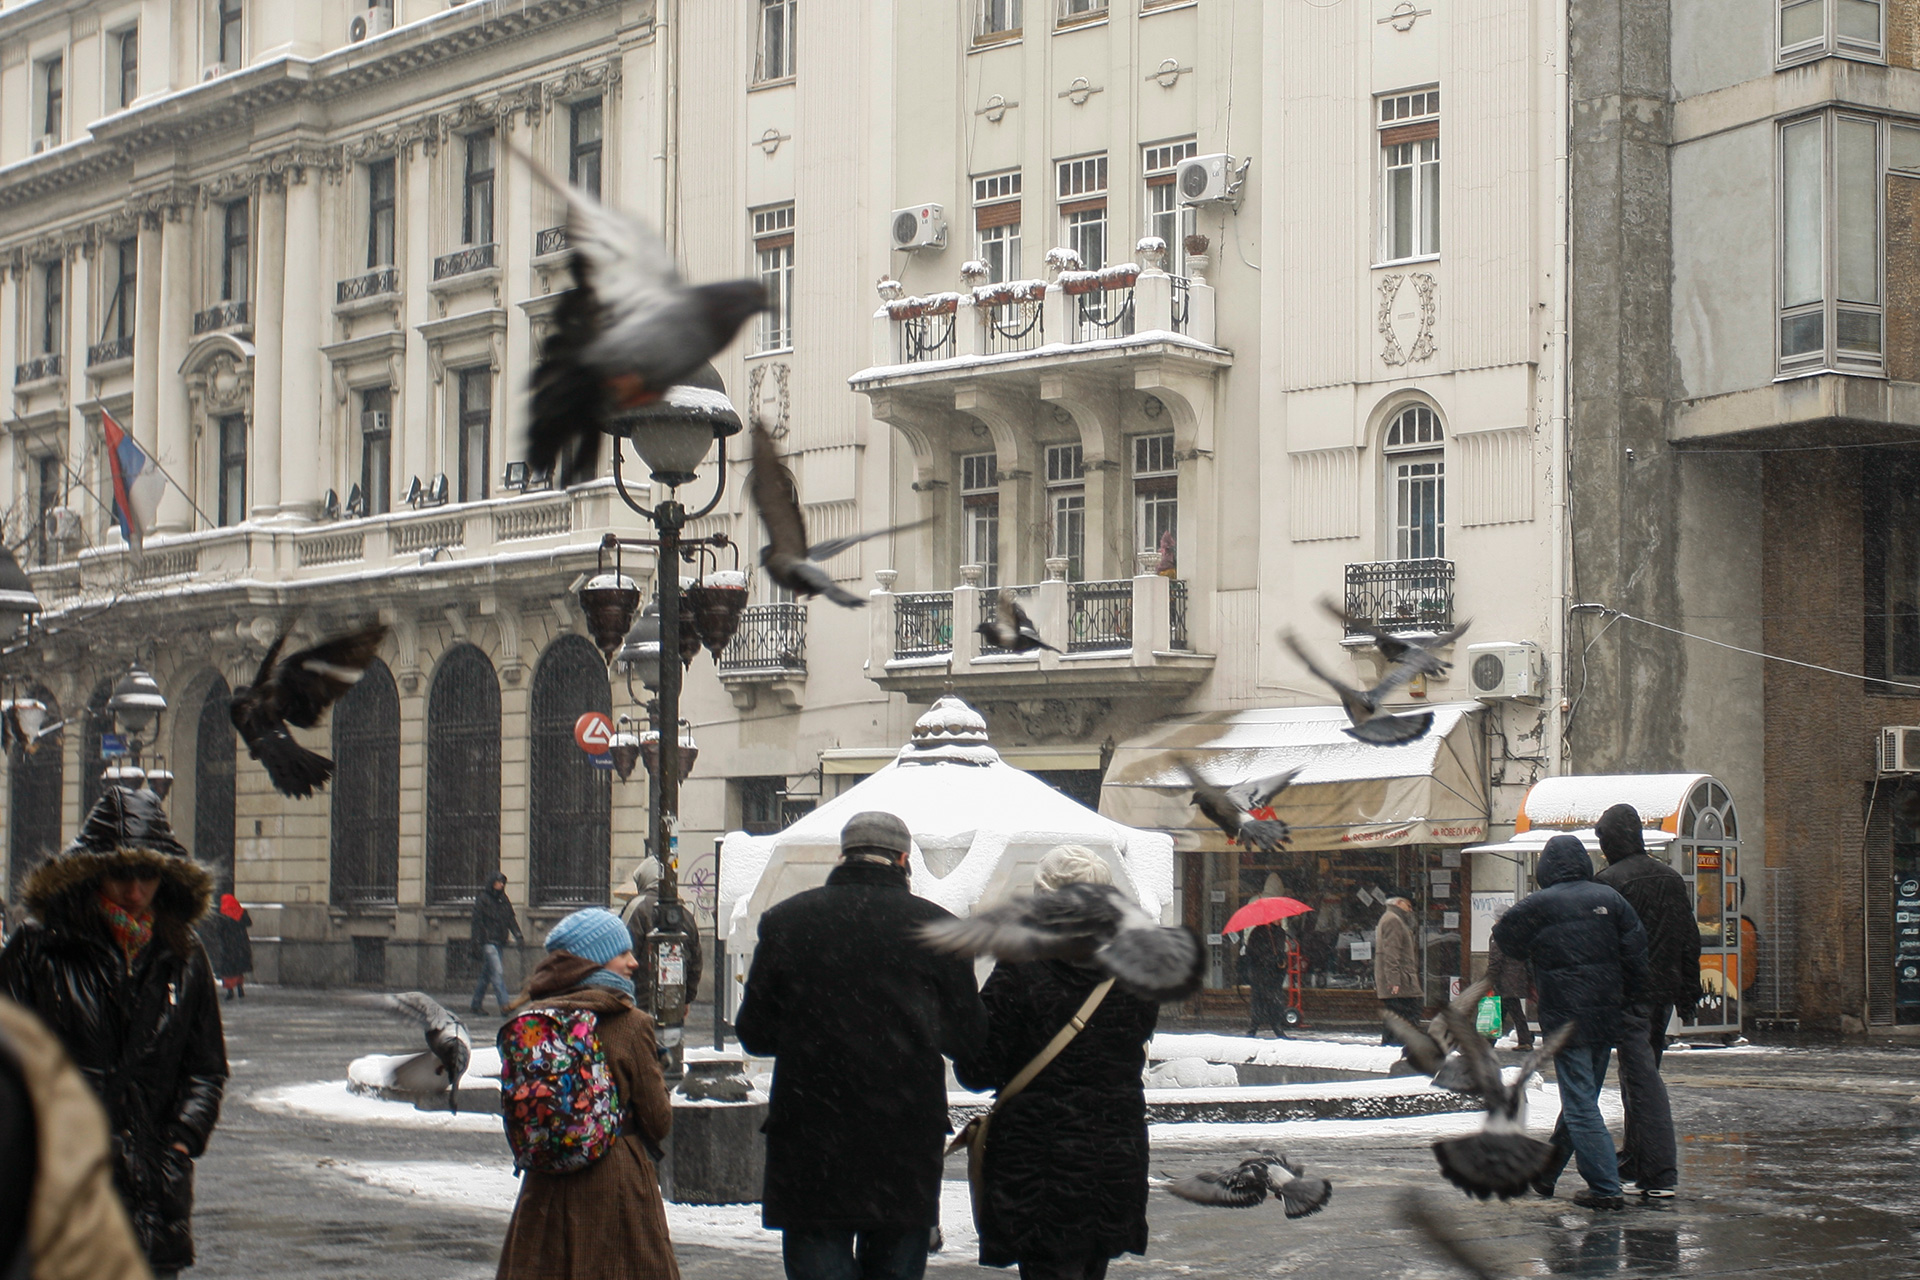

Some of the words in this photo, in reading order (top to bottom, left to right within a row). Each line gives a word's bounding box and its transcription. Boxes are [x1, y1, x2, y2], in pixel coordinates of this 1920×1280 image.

[1441, 827, 1456, 837] ROBE
[1464, 826, 1482, 836] KAPPA
[1352, 832, 1373, 842] ROBE
